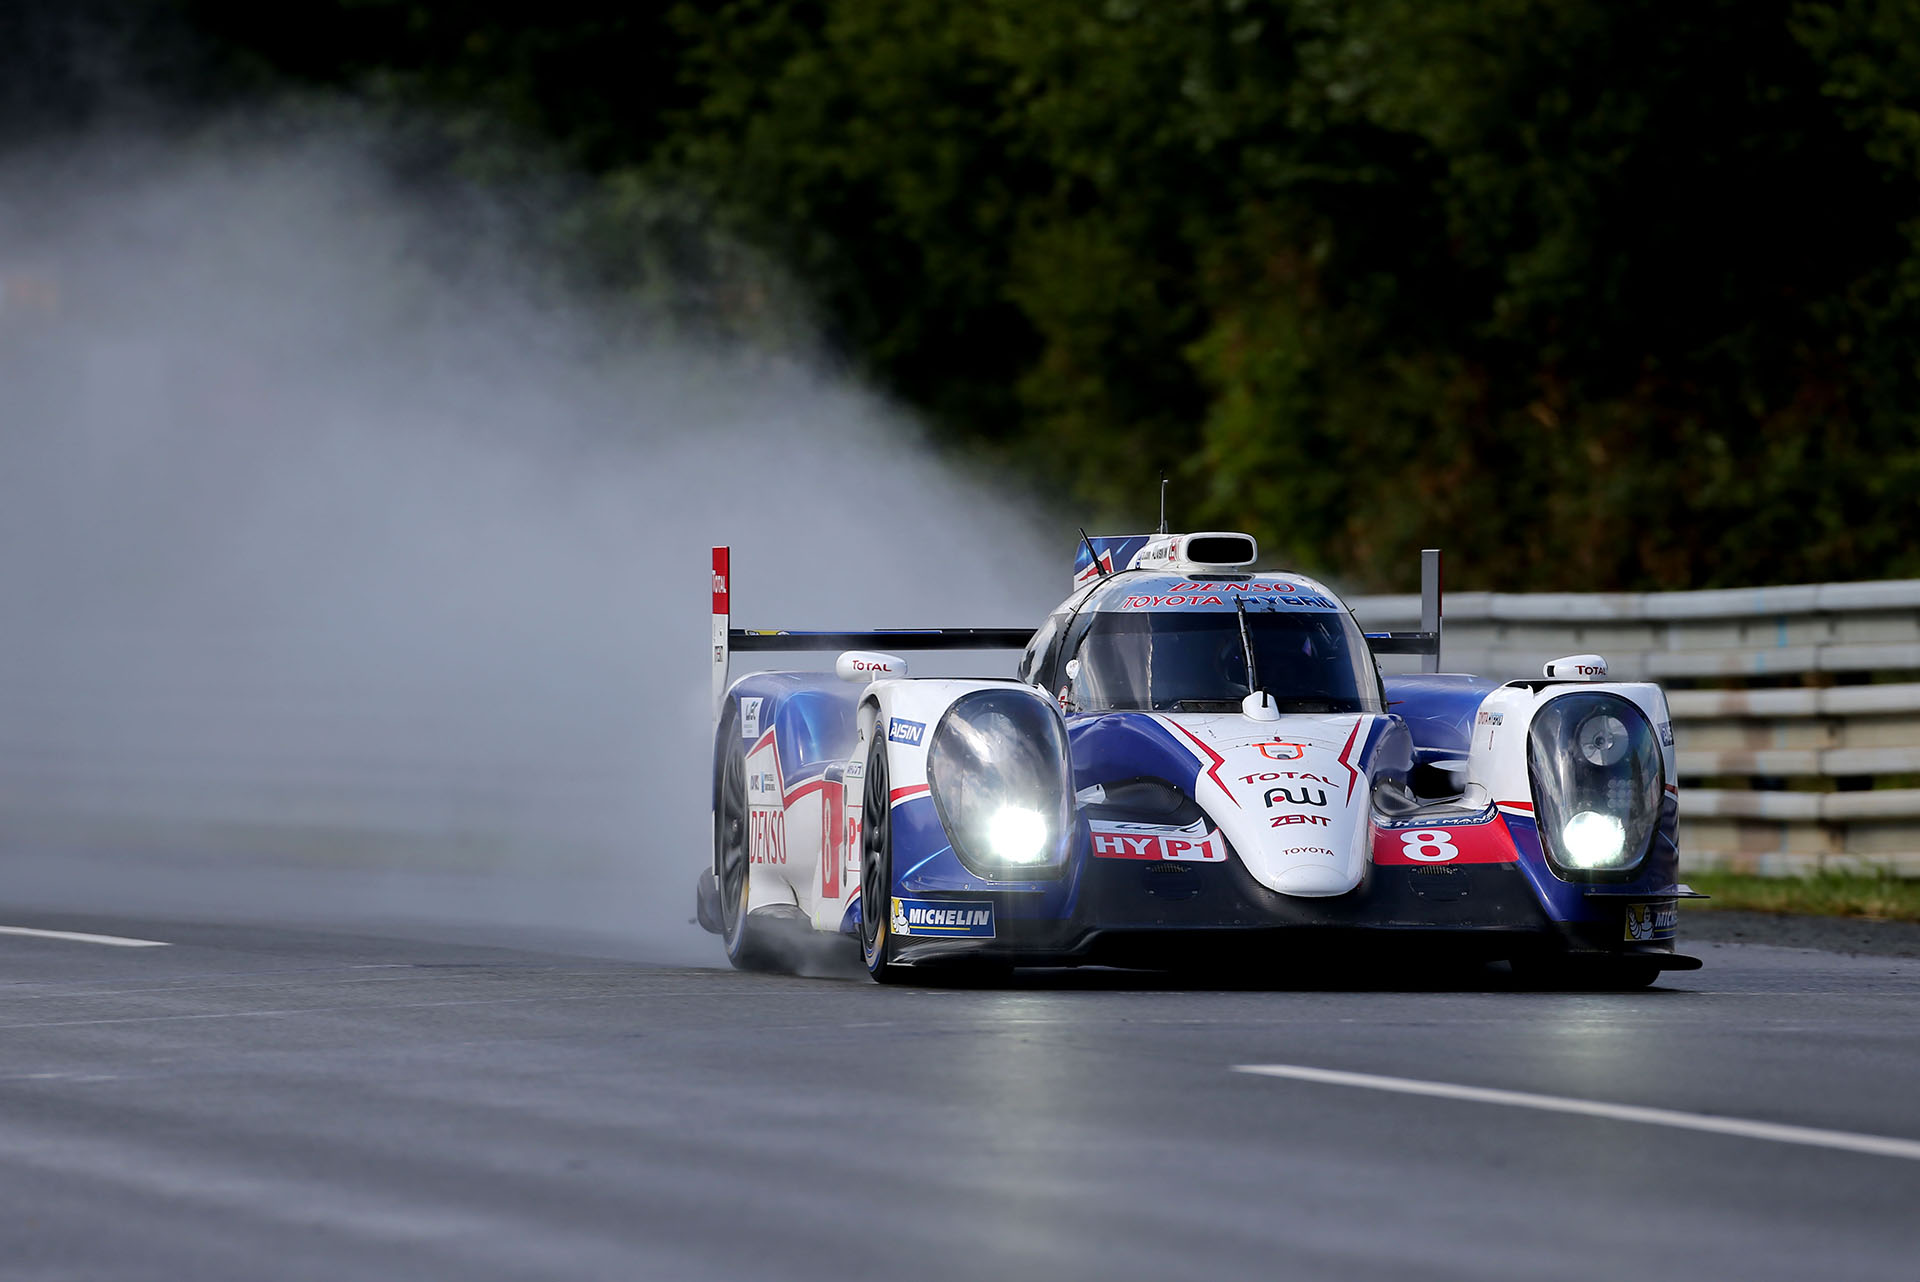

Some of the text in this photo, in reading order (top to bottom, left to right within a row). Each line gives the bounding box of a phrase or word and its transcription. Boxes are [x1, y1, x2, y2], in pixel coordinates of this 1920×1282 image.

[1169, 582, 1296, 593] DENSO
[1121, 594, 1338, 610] TOYOTA HYBRID
[852, 660, 892, 672] TOTAL
[889, 721, 922, 742] AISIN
[1238, 771, 1340, 788] TOTAL
[1269, 814, 1332, 828] ZENT
[750, 810, 787, 865] DENSO
[824, 797, 832, 884] 8
[1400, 829, 1459, 862] 8
[1094, 835, 1214, 859] HY P1
[1282, 846, 1335, 857] TOYOTA
[909, 908, 990, 926] MICHELIN
